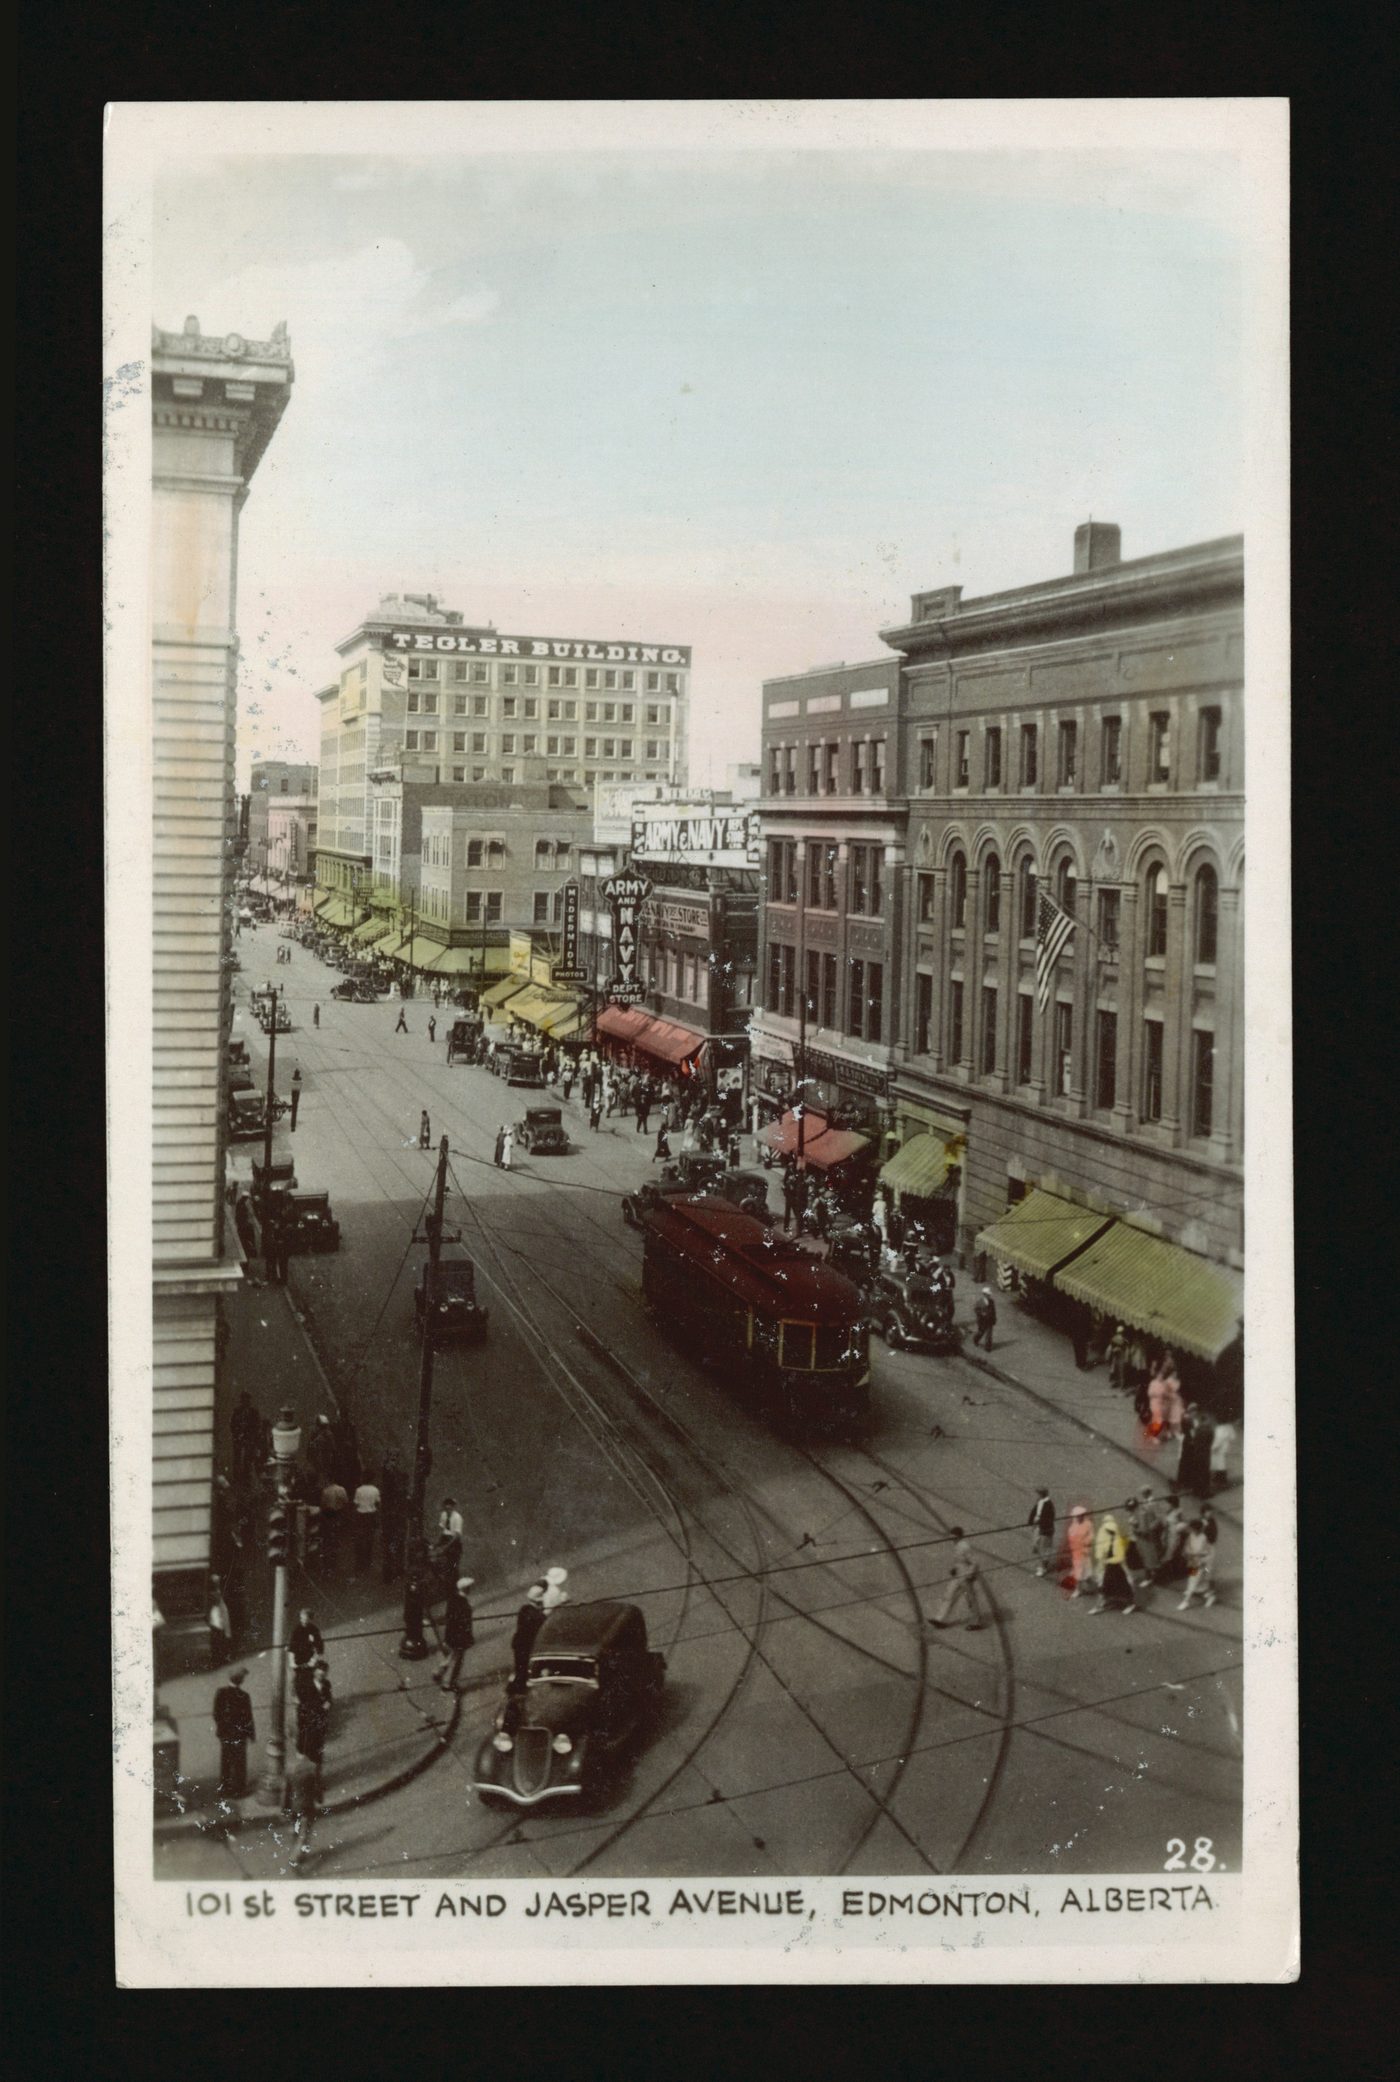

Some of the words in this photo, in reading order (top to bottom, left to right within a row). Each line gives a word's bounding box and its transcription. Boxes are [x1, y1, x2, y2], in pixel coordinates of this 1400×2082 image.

[393, 633, 520, 655] TEGLER
[531, 641, 686, 664] BUILDING.
[645, 820, 681, 850] ARMY
[687, 818, 726, 850] NAVY
[604, 880, 649, 896] ARMY
[617, 897, 636, 905] AND
[619, 907, 635, 982] NAVY
[612, 984, 641, 993] DEPT.
[609, 994, 643, 1003] STORE
